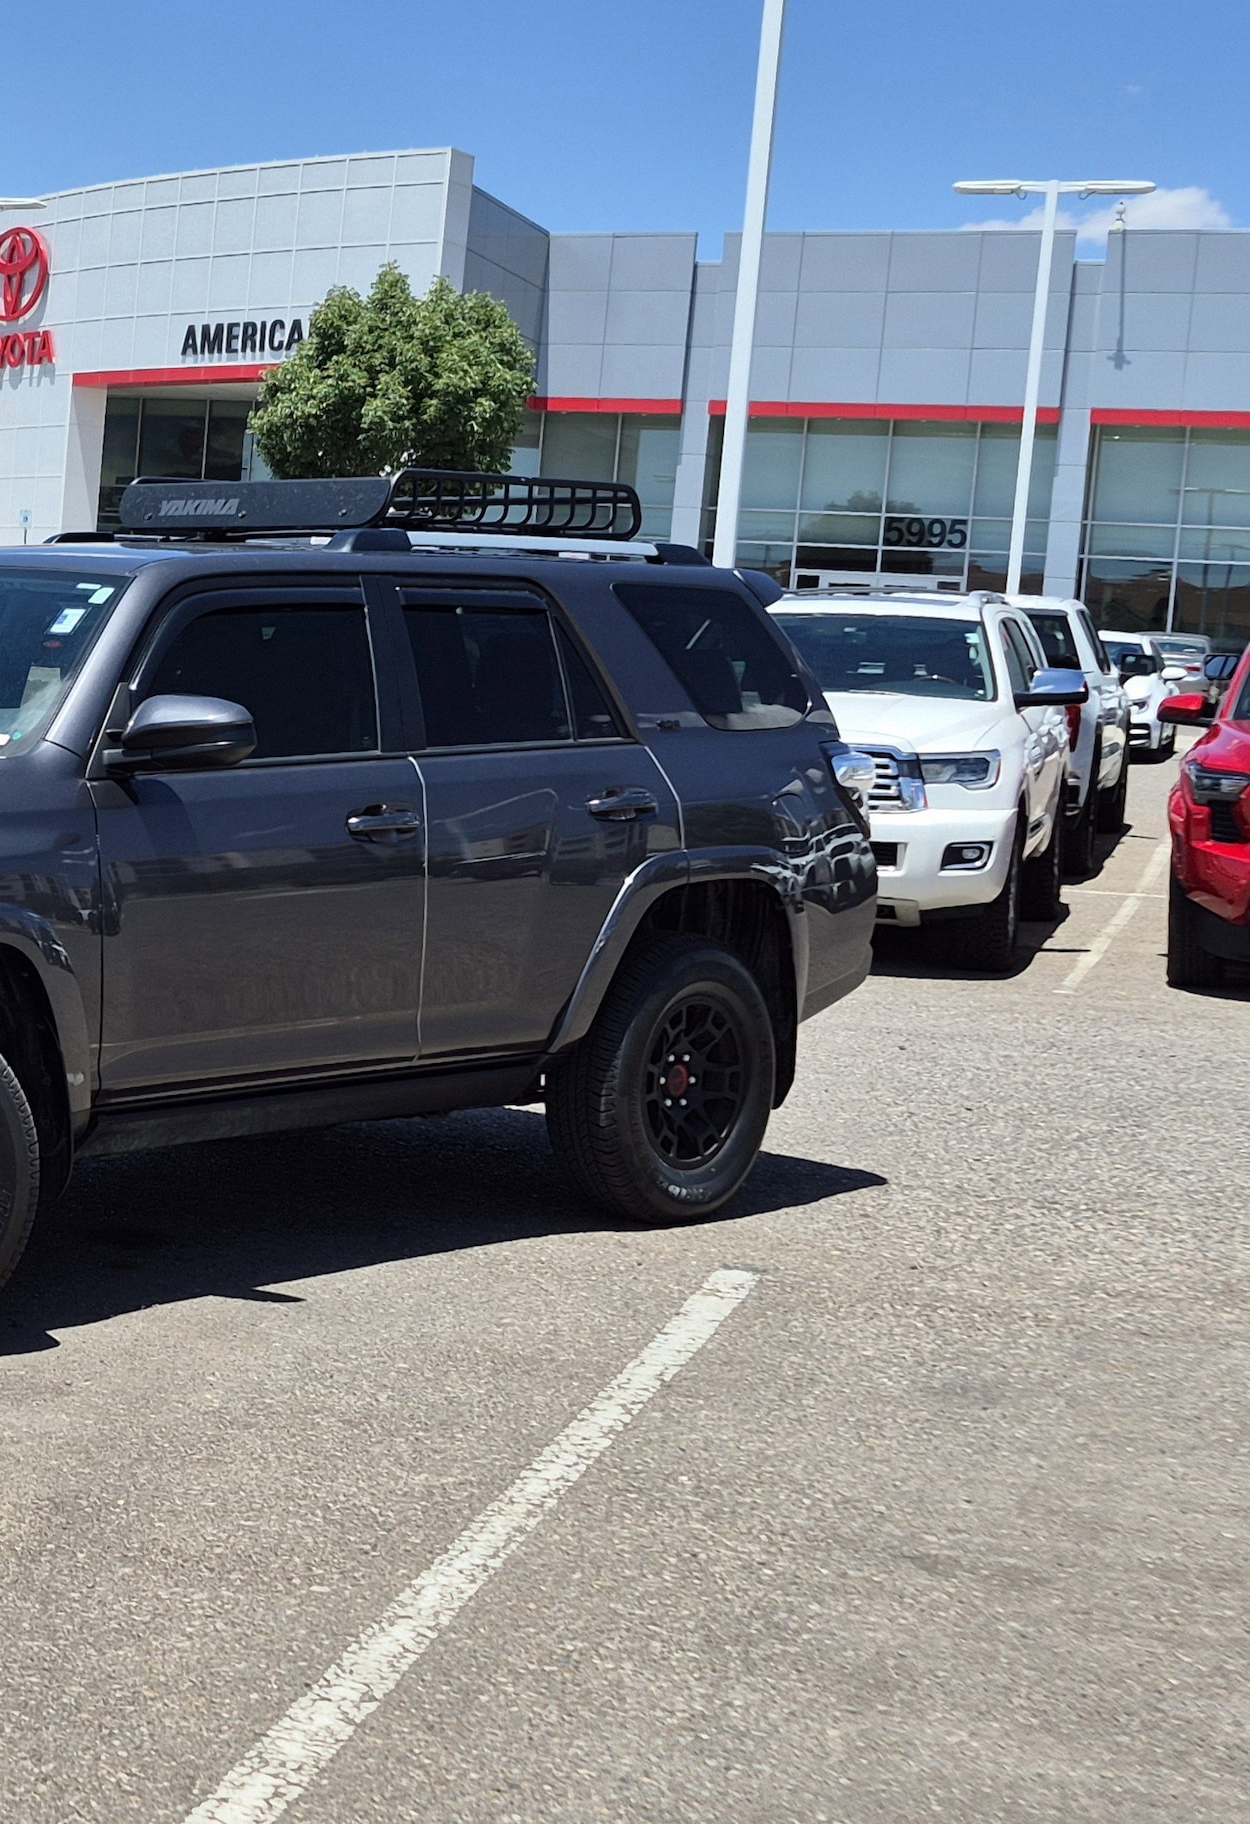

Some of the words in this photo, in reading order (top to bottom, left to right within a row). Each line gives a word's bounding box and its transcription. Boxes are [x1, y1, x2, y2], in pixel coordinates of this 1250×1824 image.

[181, 319, 312, 356] AMERICA
[158, 498, 240, 517] YAKIMA
[885, 518, 968, 548] 5995
